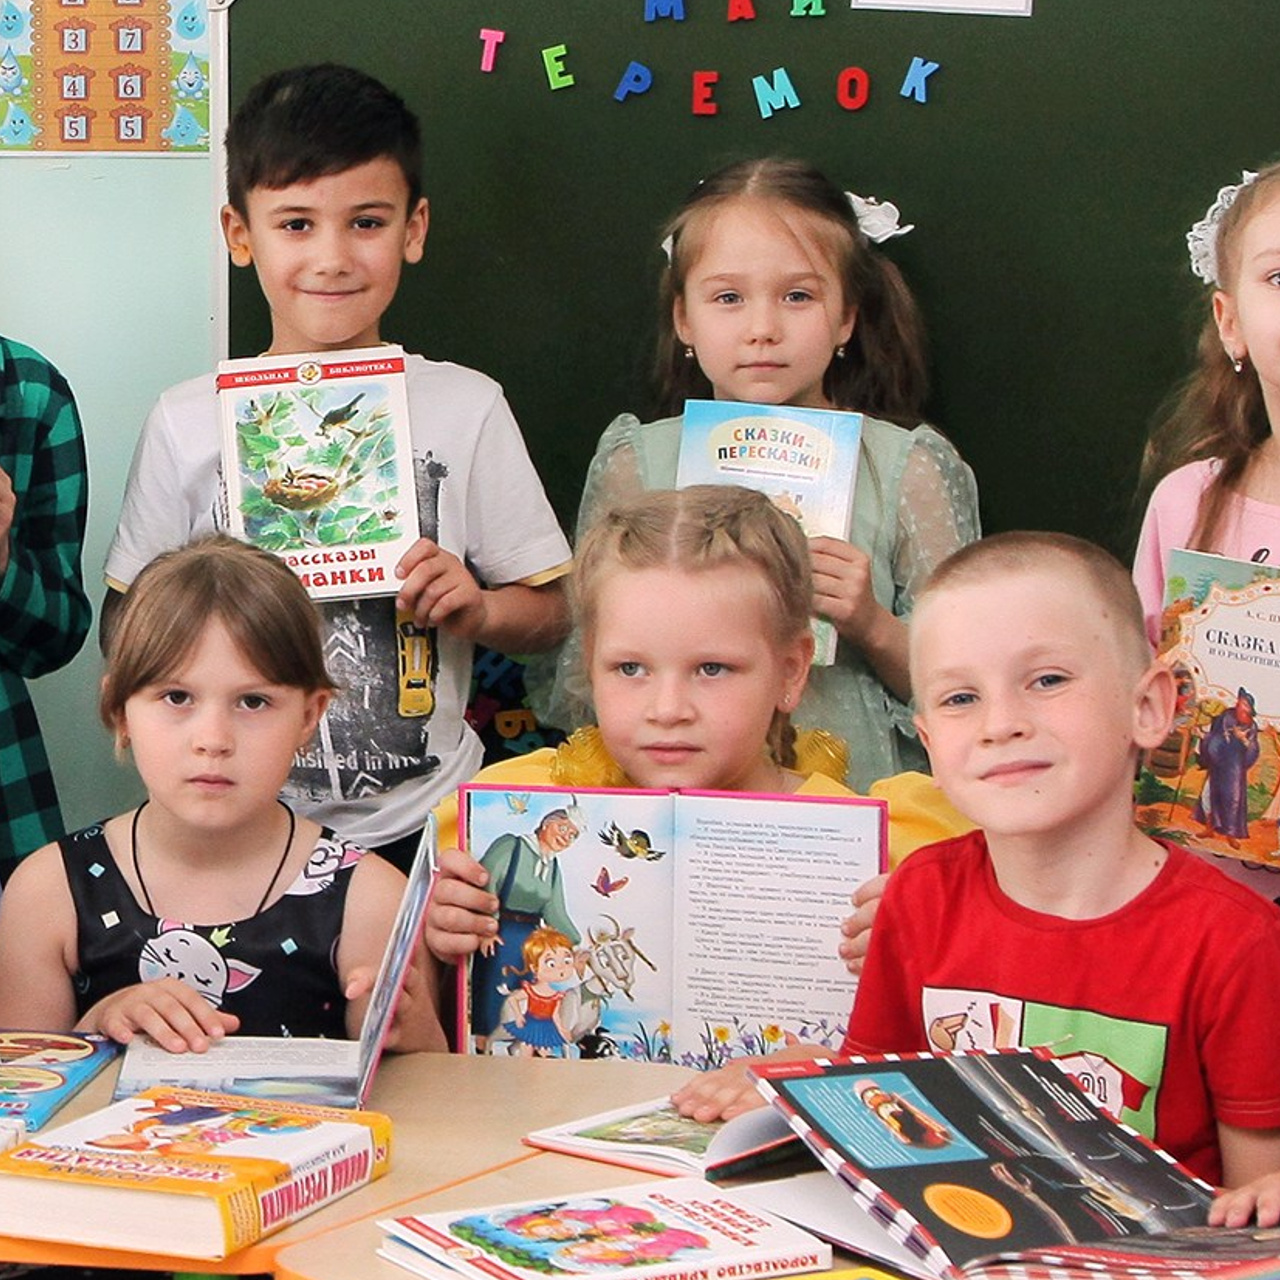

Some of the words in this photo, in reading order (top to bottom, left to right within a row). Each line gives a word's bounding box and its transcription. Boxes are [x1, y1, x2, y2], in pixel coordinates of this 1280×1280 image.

[68, 32, 79, 50] 3
[125, 32, 136, 49] 7
[67, 80, 79, 97] 4
[123, 78, 135, 96] 6
[68, 120, 79, 138] 5
[124, 119, 135, 138] 5
[717, 446, 822, 470] ПЕРЕСКАЗКИ
[1205, 628, 1275, 657] СКАЗКА
[716, 1254, 818, 1278] КОРОЛЕВСТВО
